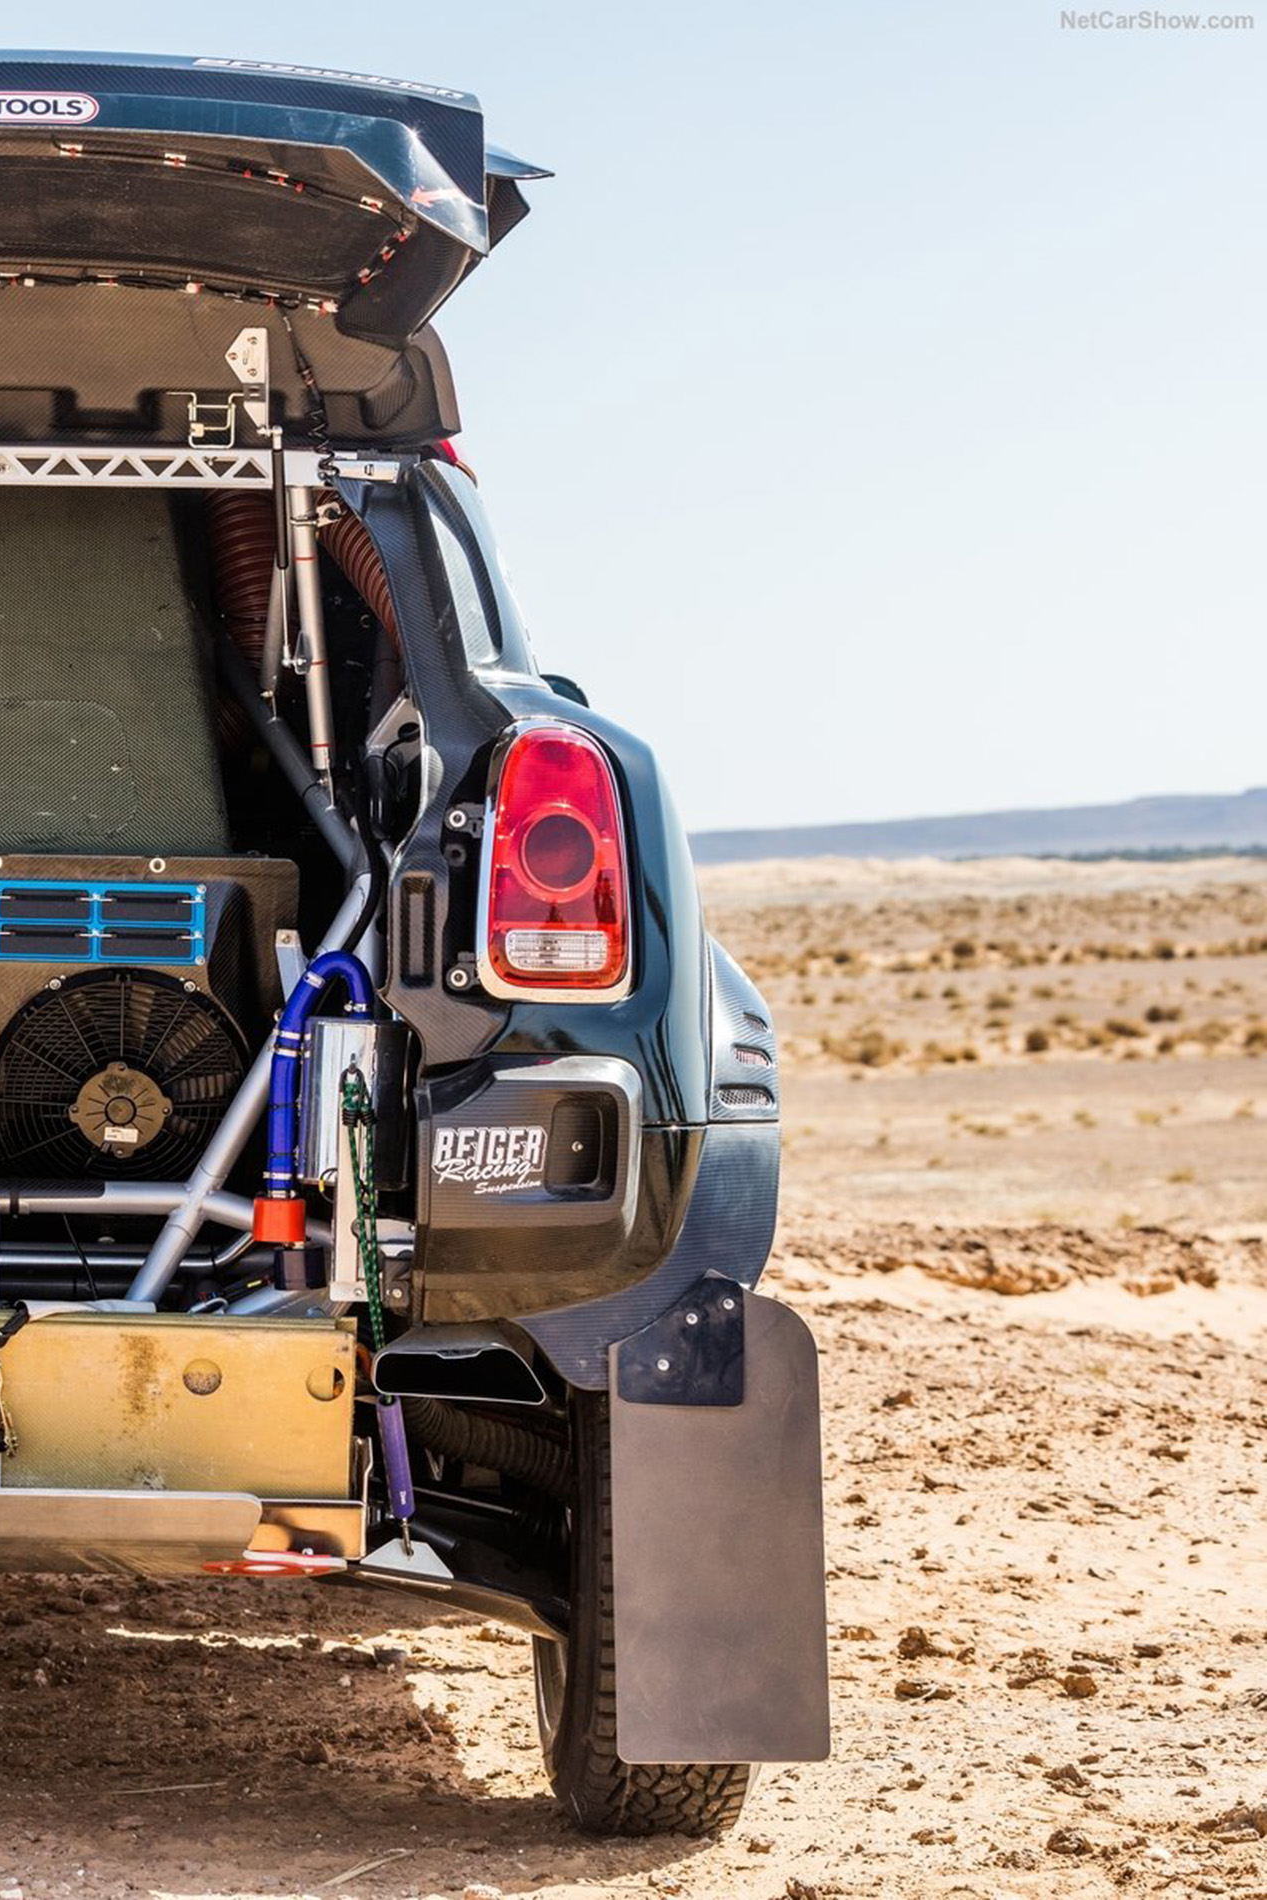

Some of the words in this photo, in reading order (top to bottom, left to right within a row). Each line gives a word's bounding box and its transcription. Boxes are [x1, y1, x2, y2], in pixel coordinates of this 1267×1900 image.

[433, 1126, 545, 1167] REIGER
[436, 1158, 533, 1184] Racing
[473, 1179, 543, 1195] Suspension
